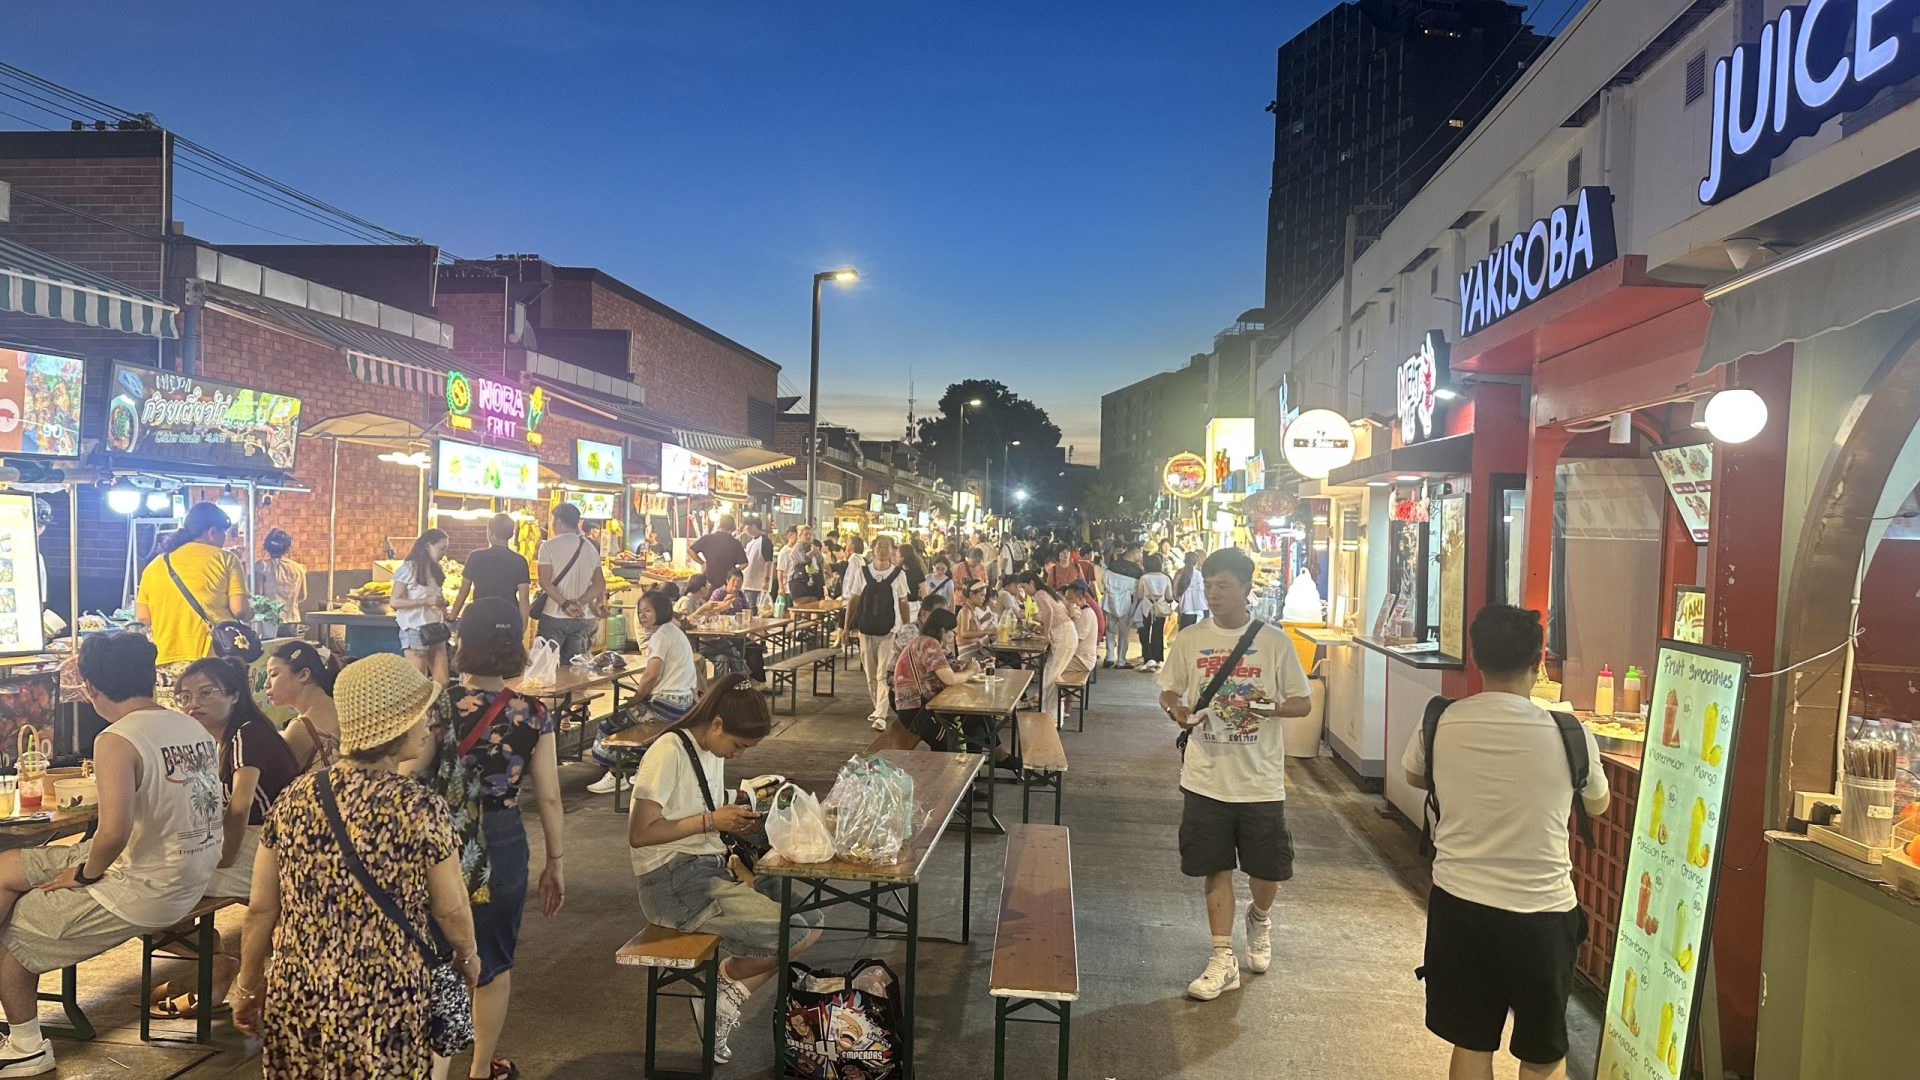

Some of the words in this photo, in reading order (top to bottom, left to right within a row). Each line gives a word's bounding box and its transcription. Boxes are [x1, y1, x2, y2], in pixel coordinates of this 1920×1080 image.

[1700, 0, 1899, 202] JUICE
[1460, 188, 1594, 336] YAKISOBA
[478, 378, 524, 419] NORA
[487, 416, 517, 438] FRUIT
[1664, 655, 1685, 677] Fruit
[1688, 664, 1733, 689] Smoothies
[1649, 747, 1685, 770] Watermelon
[1694, 765, 1717, 787] Mango
[1637, 836, 1660, 858] Passion
[1661, 850, 1675, 868] Fruit
[1681, 864, 1704, 889] Orange
[1620, 930, 1651, 963] Strawberry
[1663, 961, 1687, 990] Banana
